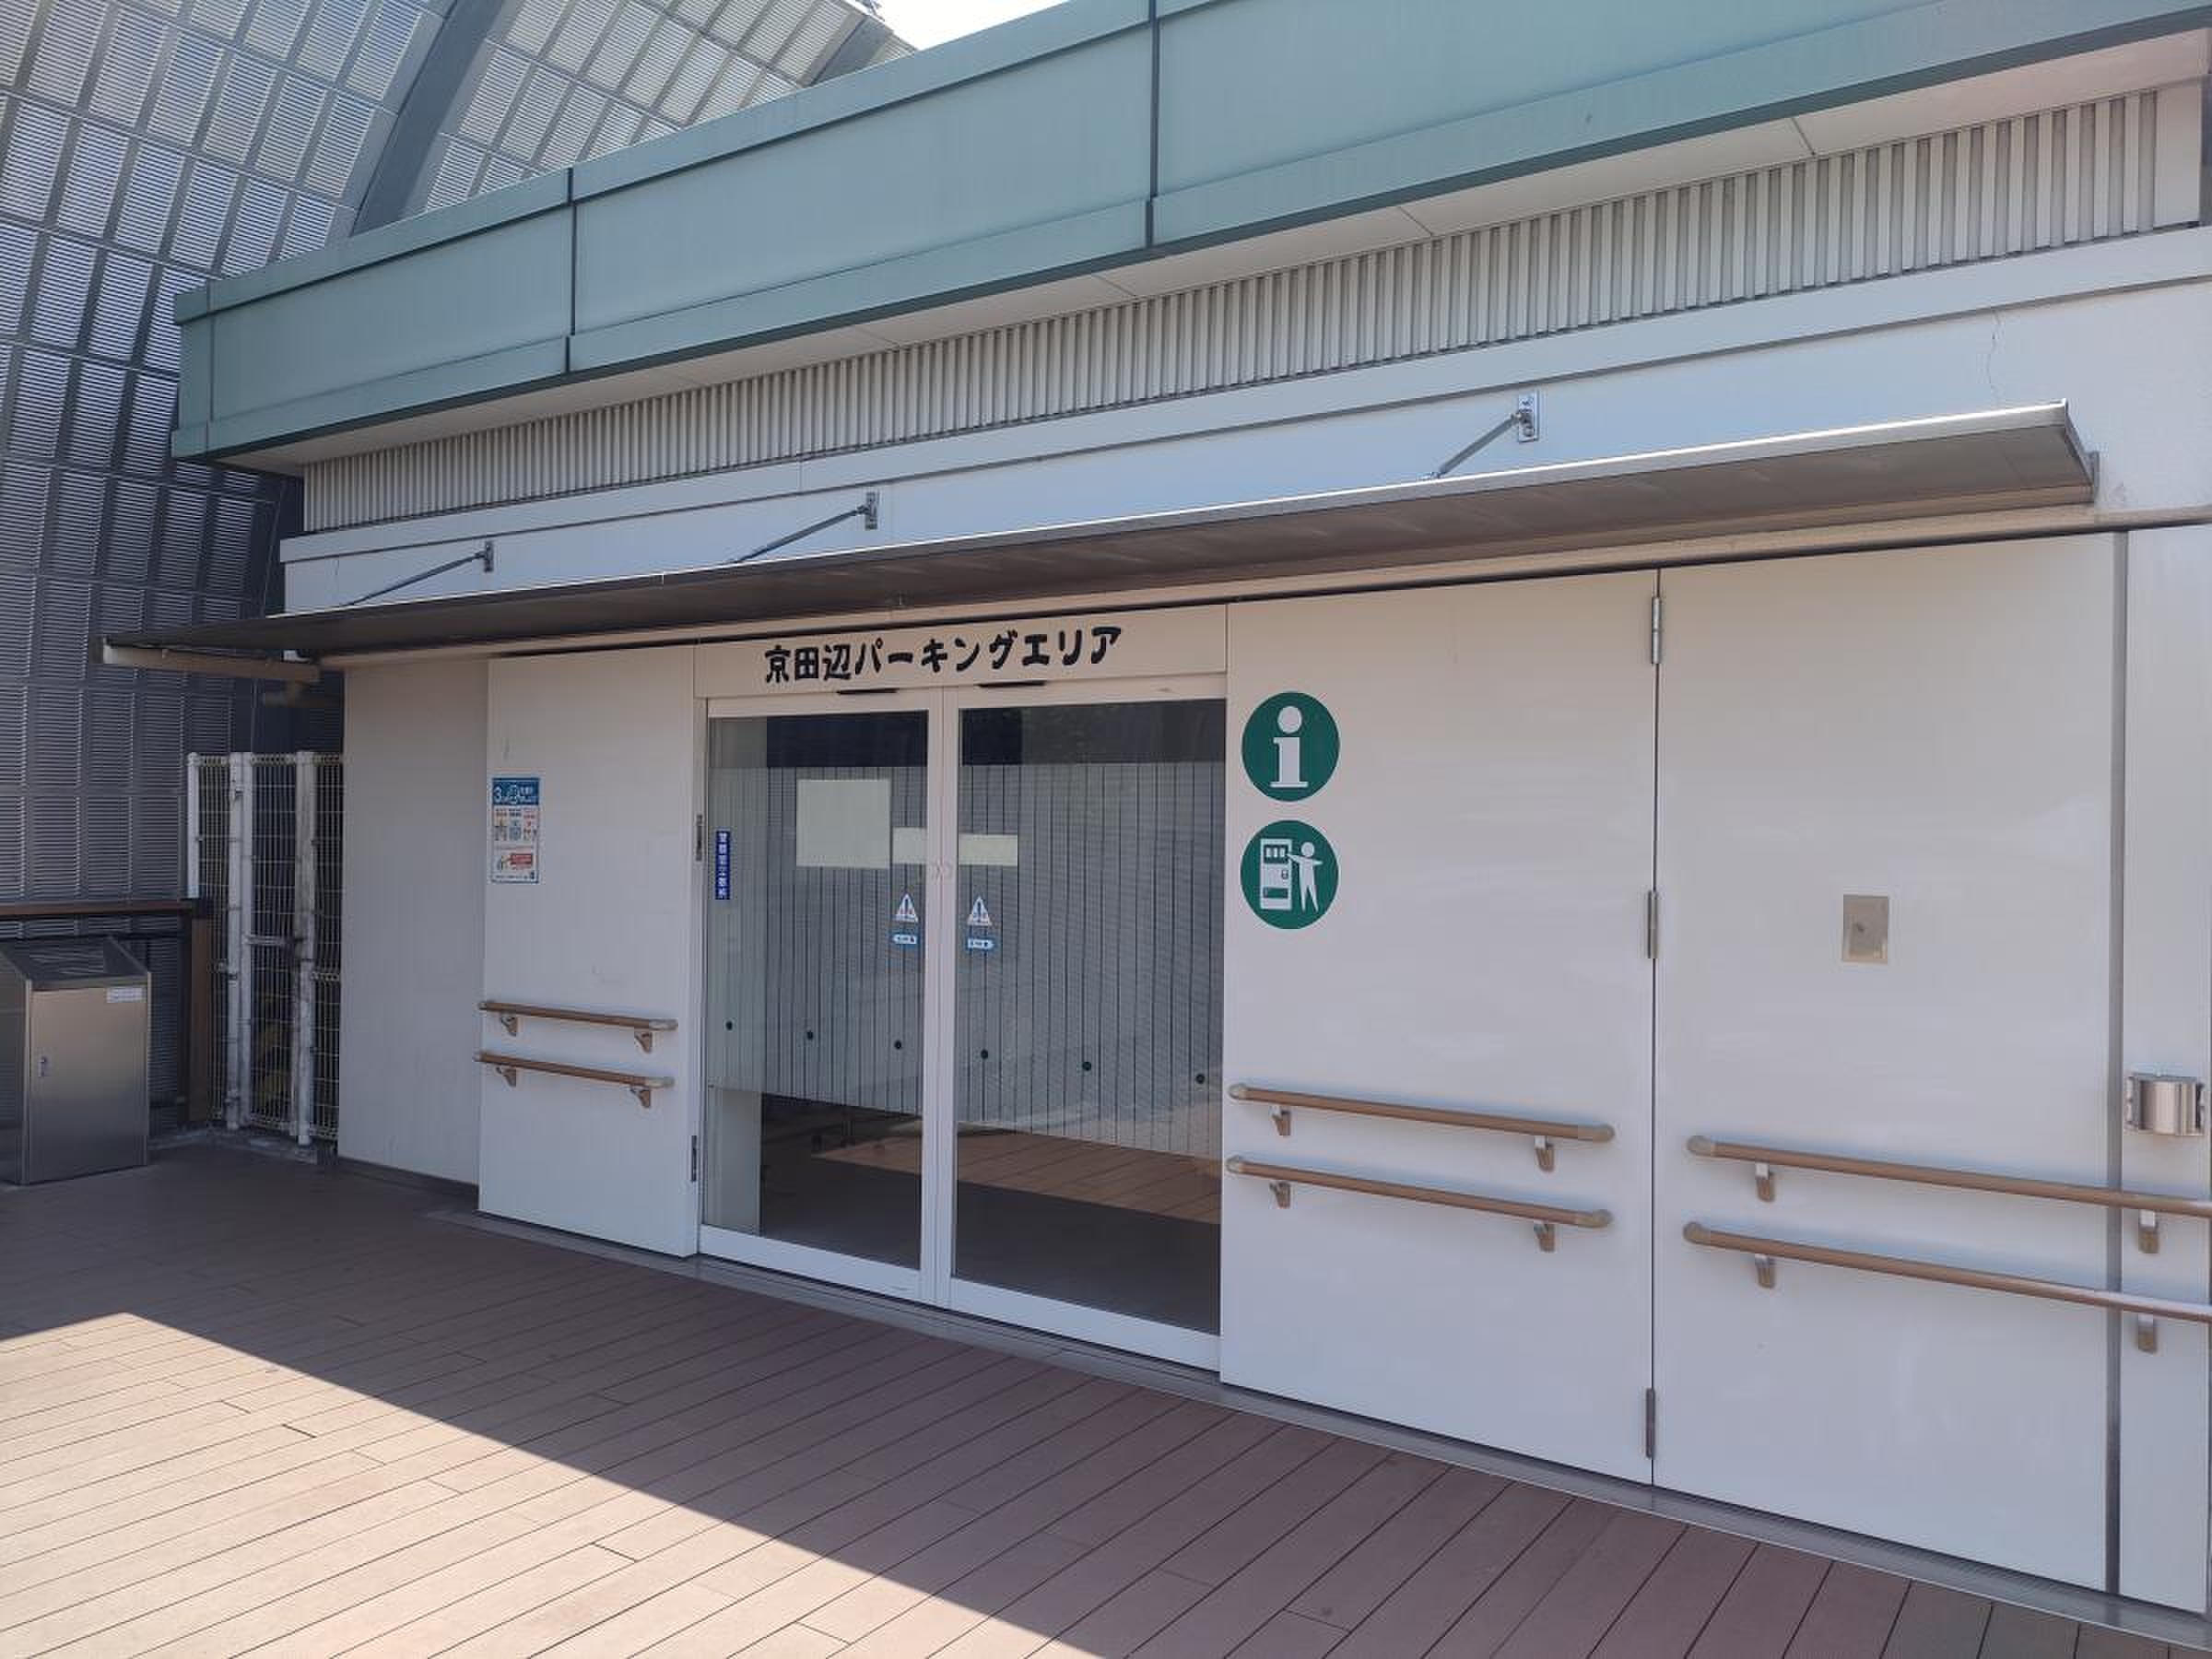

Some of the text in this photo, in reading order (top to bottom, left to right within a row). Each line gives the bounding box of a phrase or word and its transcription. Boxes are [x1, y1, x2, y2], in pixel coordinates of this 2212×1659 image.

[764, 626, 1122, 684] 京田辺パーキングエリア
